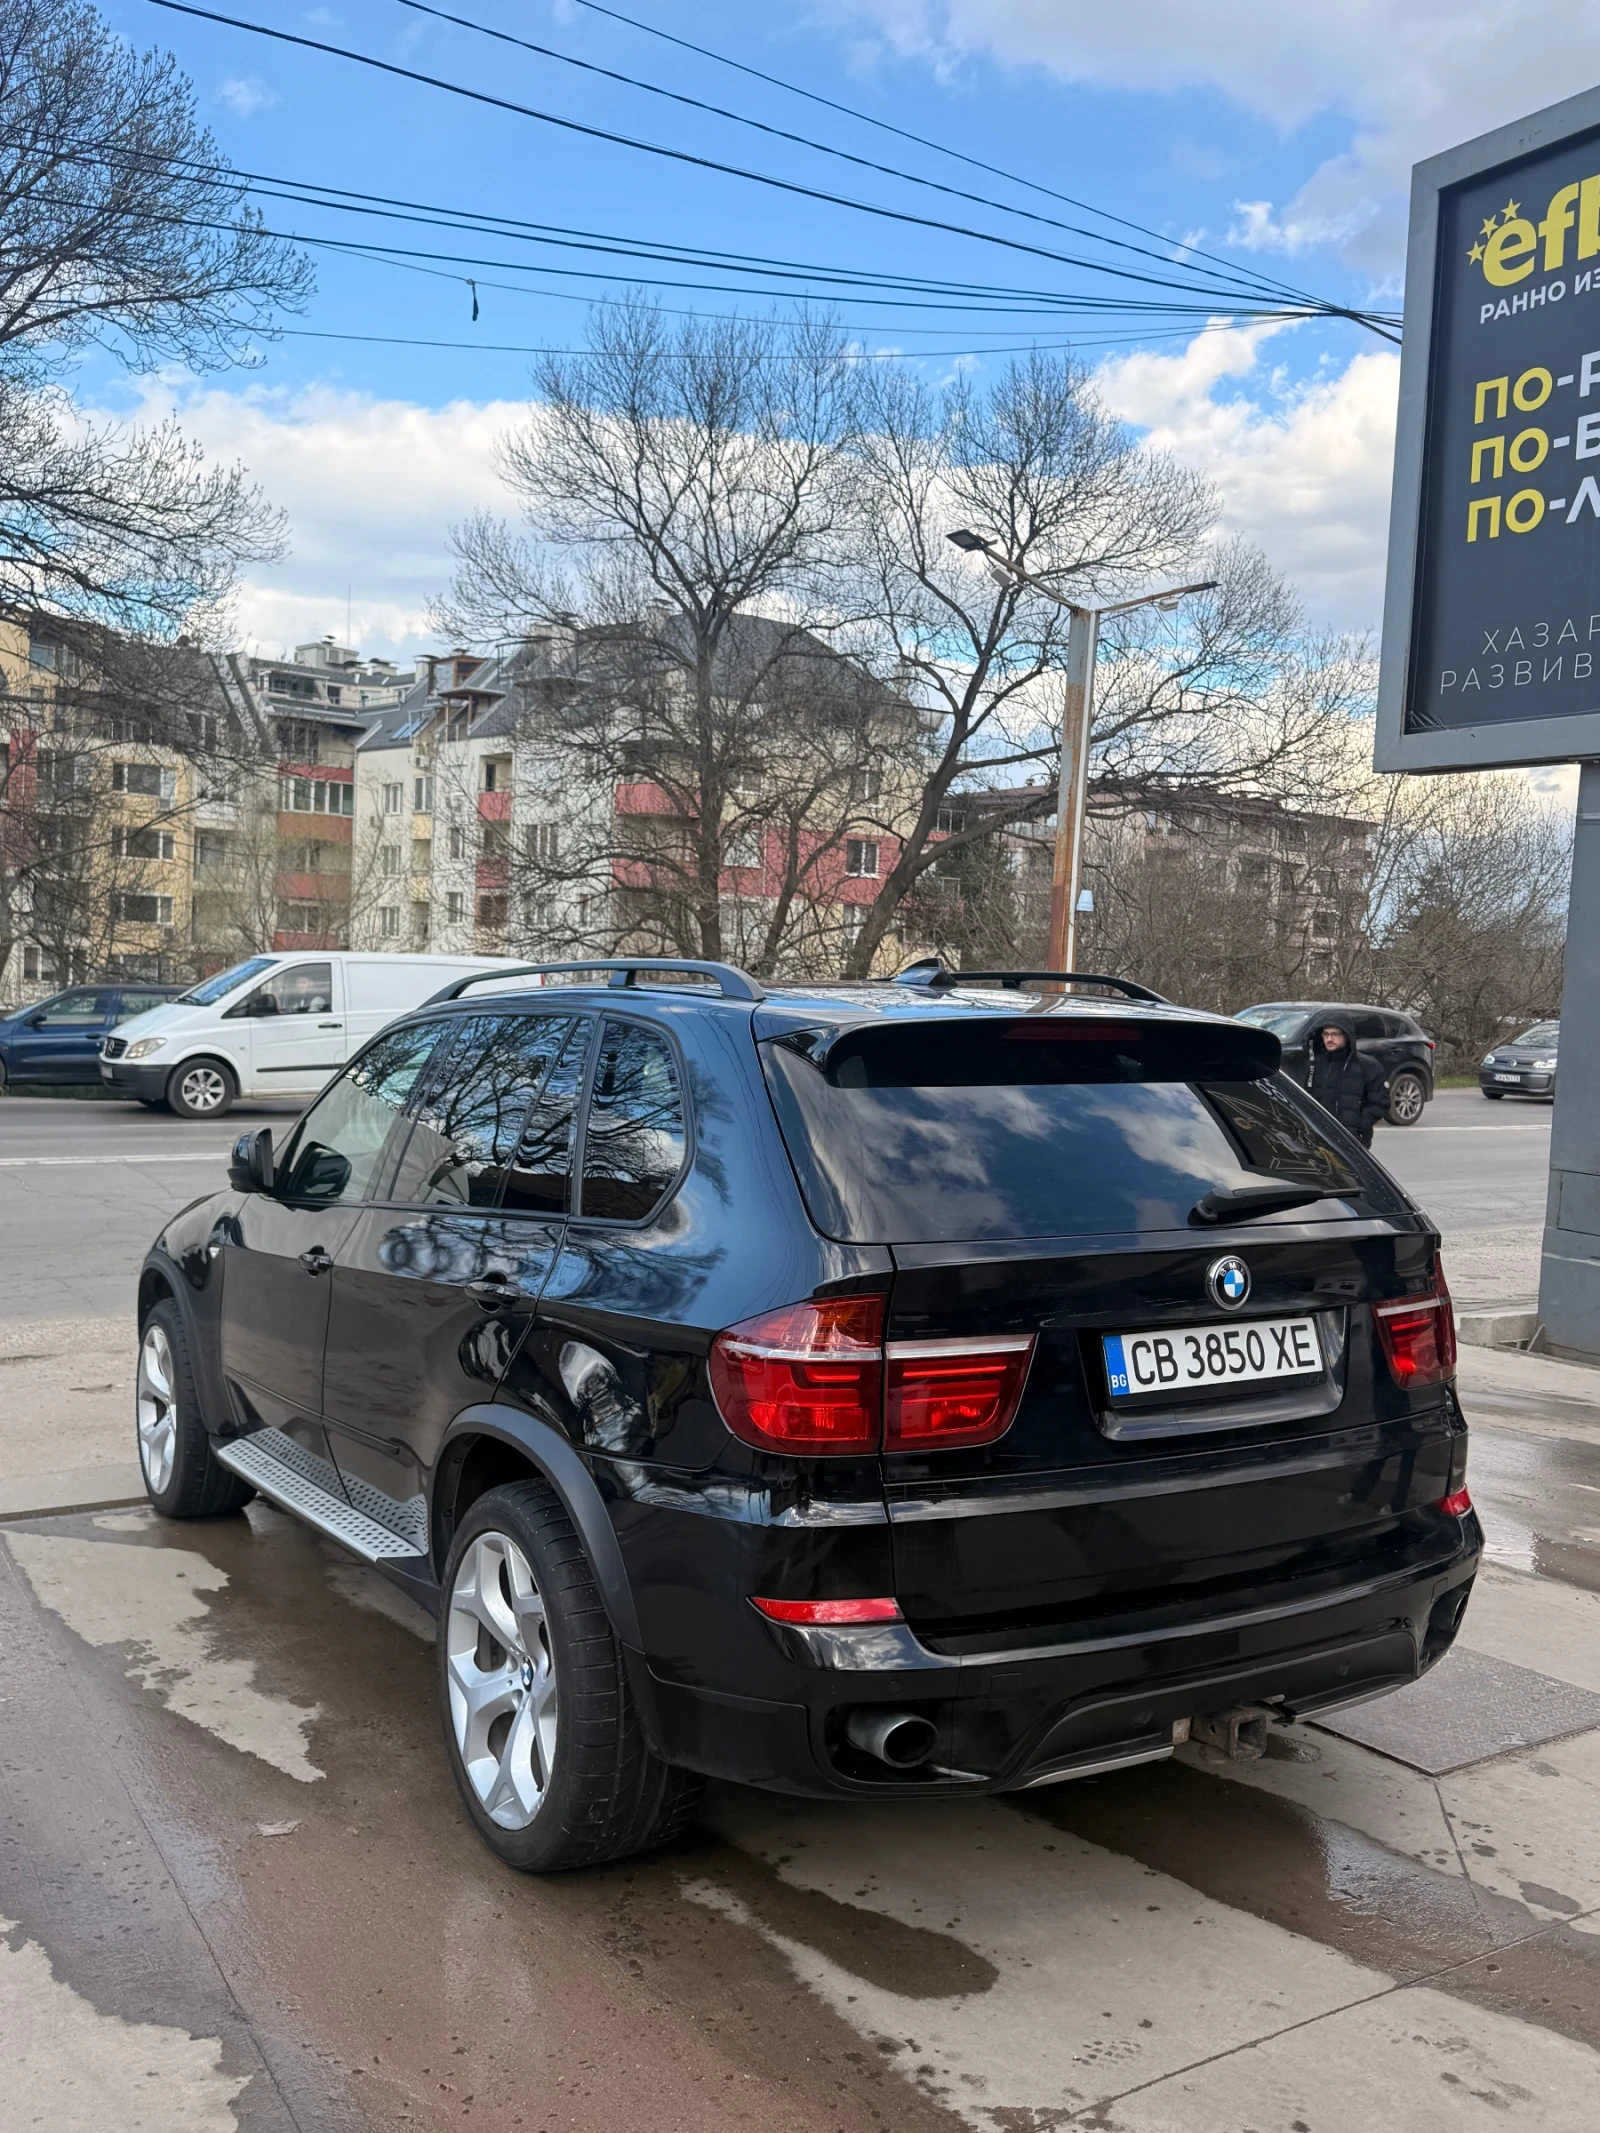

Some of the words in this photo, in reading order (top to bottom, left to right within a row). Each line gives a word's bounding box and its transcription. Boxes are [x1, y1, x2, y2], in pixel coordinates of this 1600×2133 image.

[1480, 279, 1567, 325] РАННО
[1482, 614, 1600, 656] ХАЗАР
[1440, 652, 1593, 695] РАЗВИВ
[1131, 1338, 1179, 1386] CB
[1184, 1329, 1266, 1379] 3850
[1269, 1324, 1316, 1371] XE
[1111, 1374, 1128, 1389] BG
